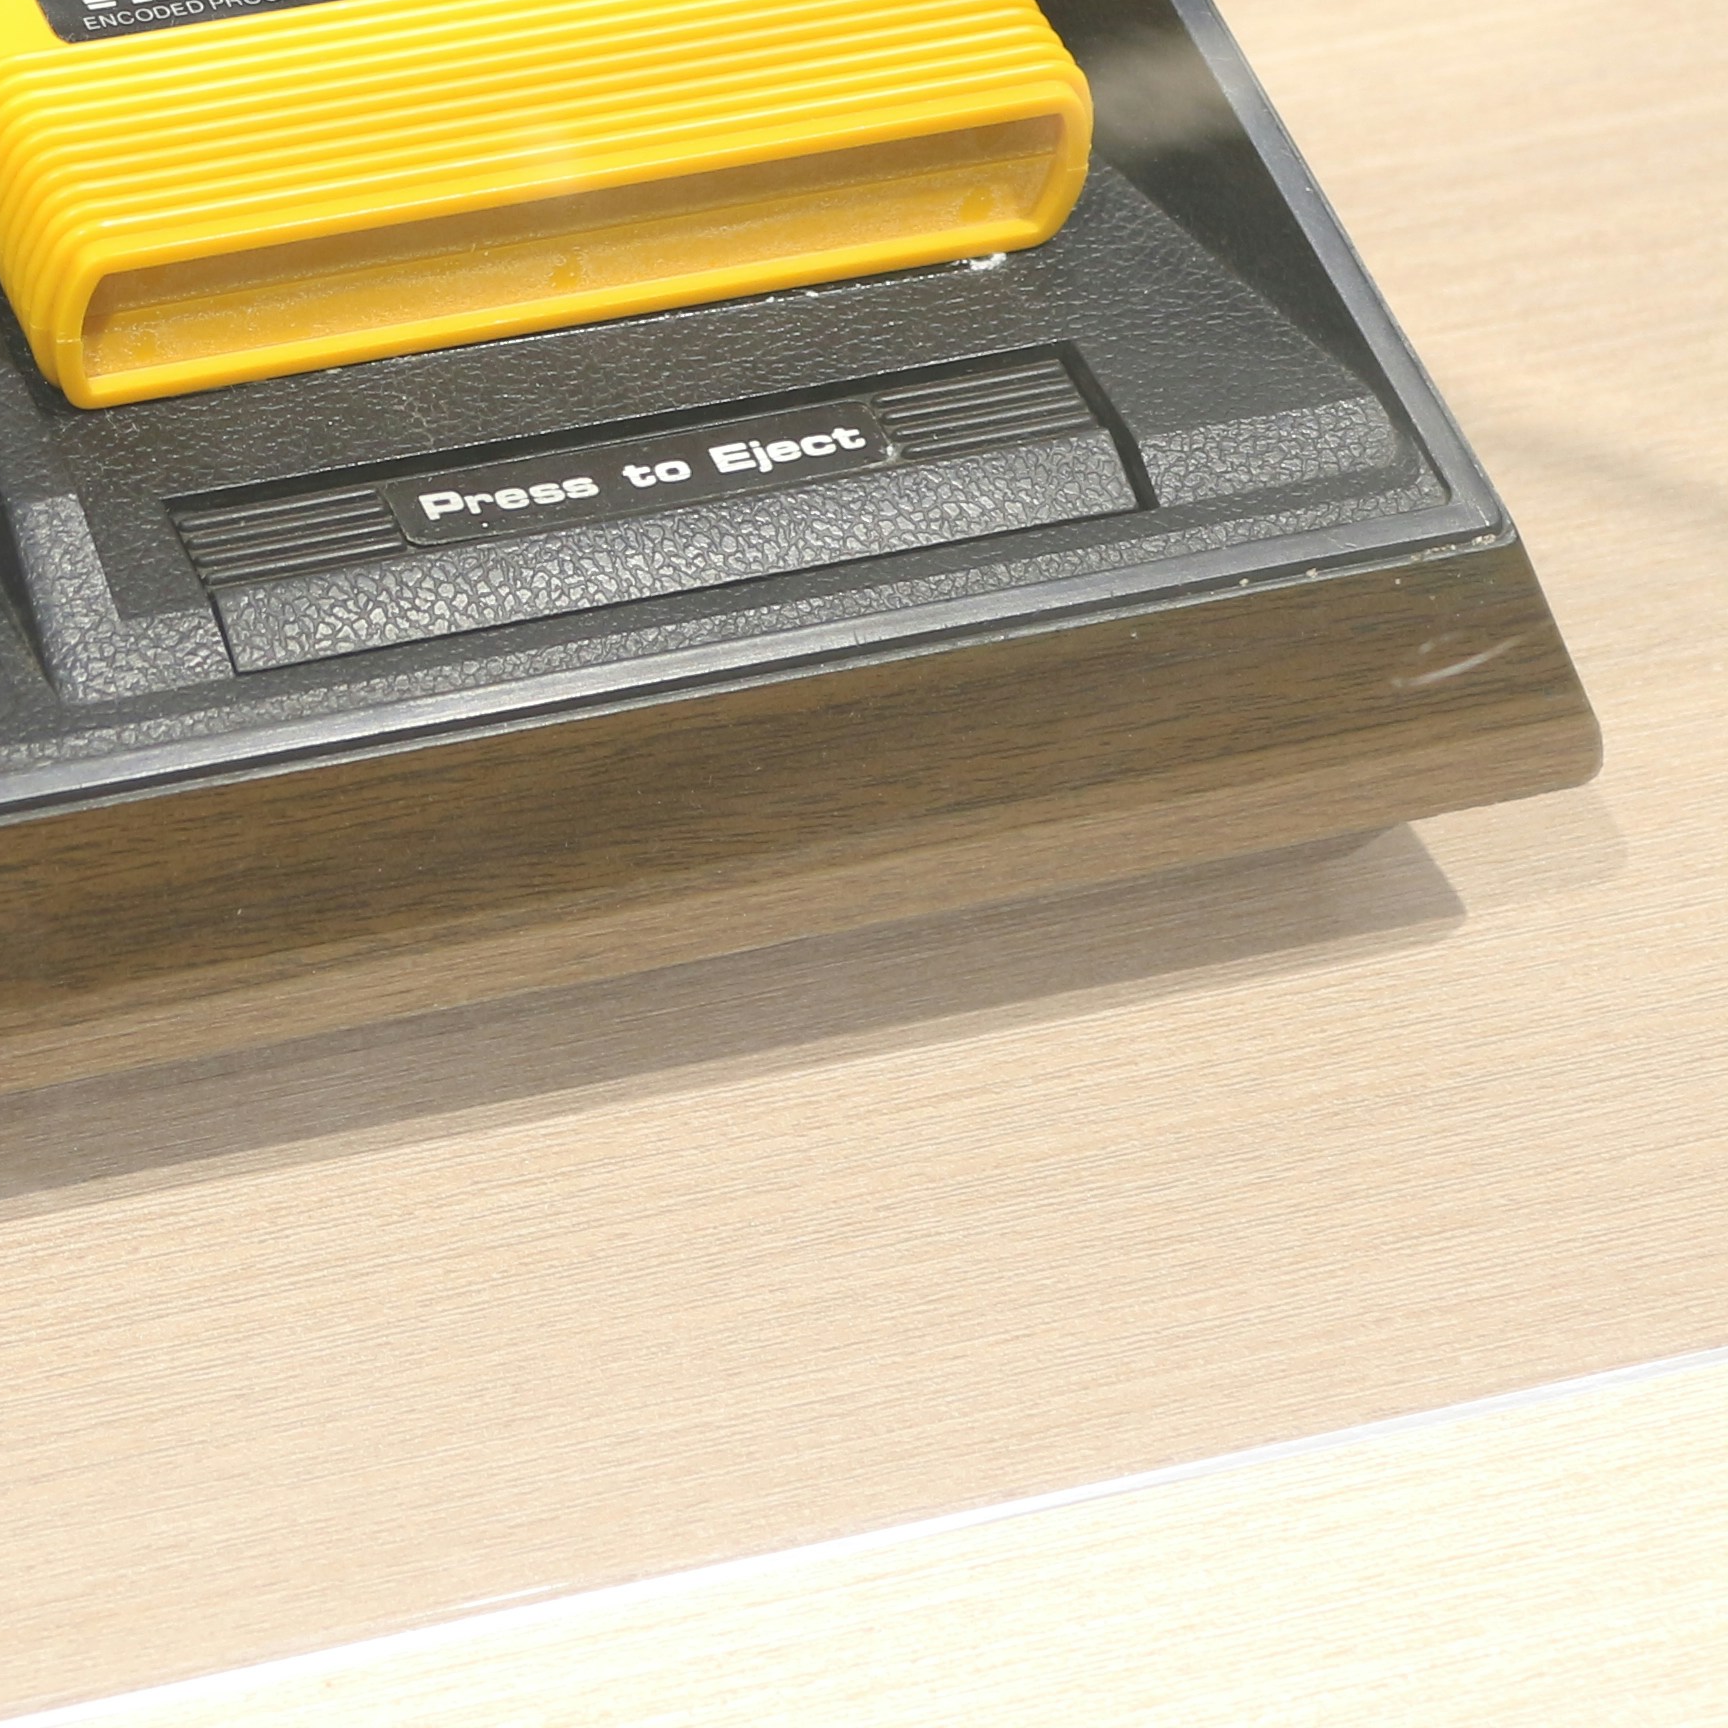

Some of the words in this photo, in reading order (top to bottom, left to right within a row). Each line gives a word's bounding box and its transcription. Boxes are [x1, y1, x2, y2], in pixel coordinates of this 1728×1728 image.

[83, 0, 204, 31] ENCODED
[418, 477, 600, 521] Press
[622, 459, 692, 488] to
[709, 426, 867, 473] Eject
